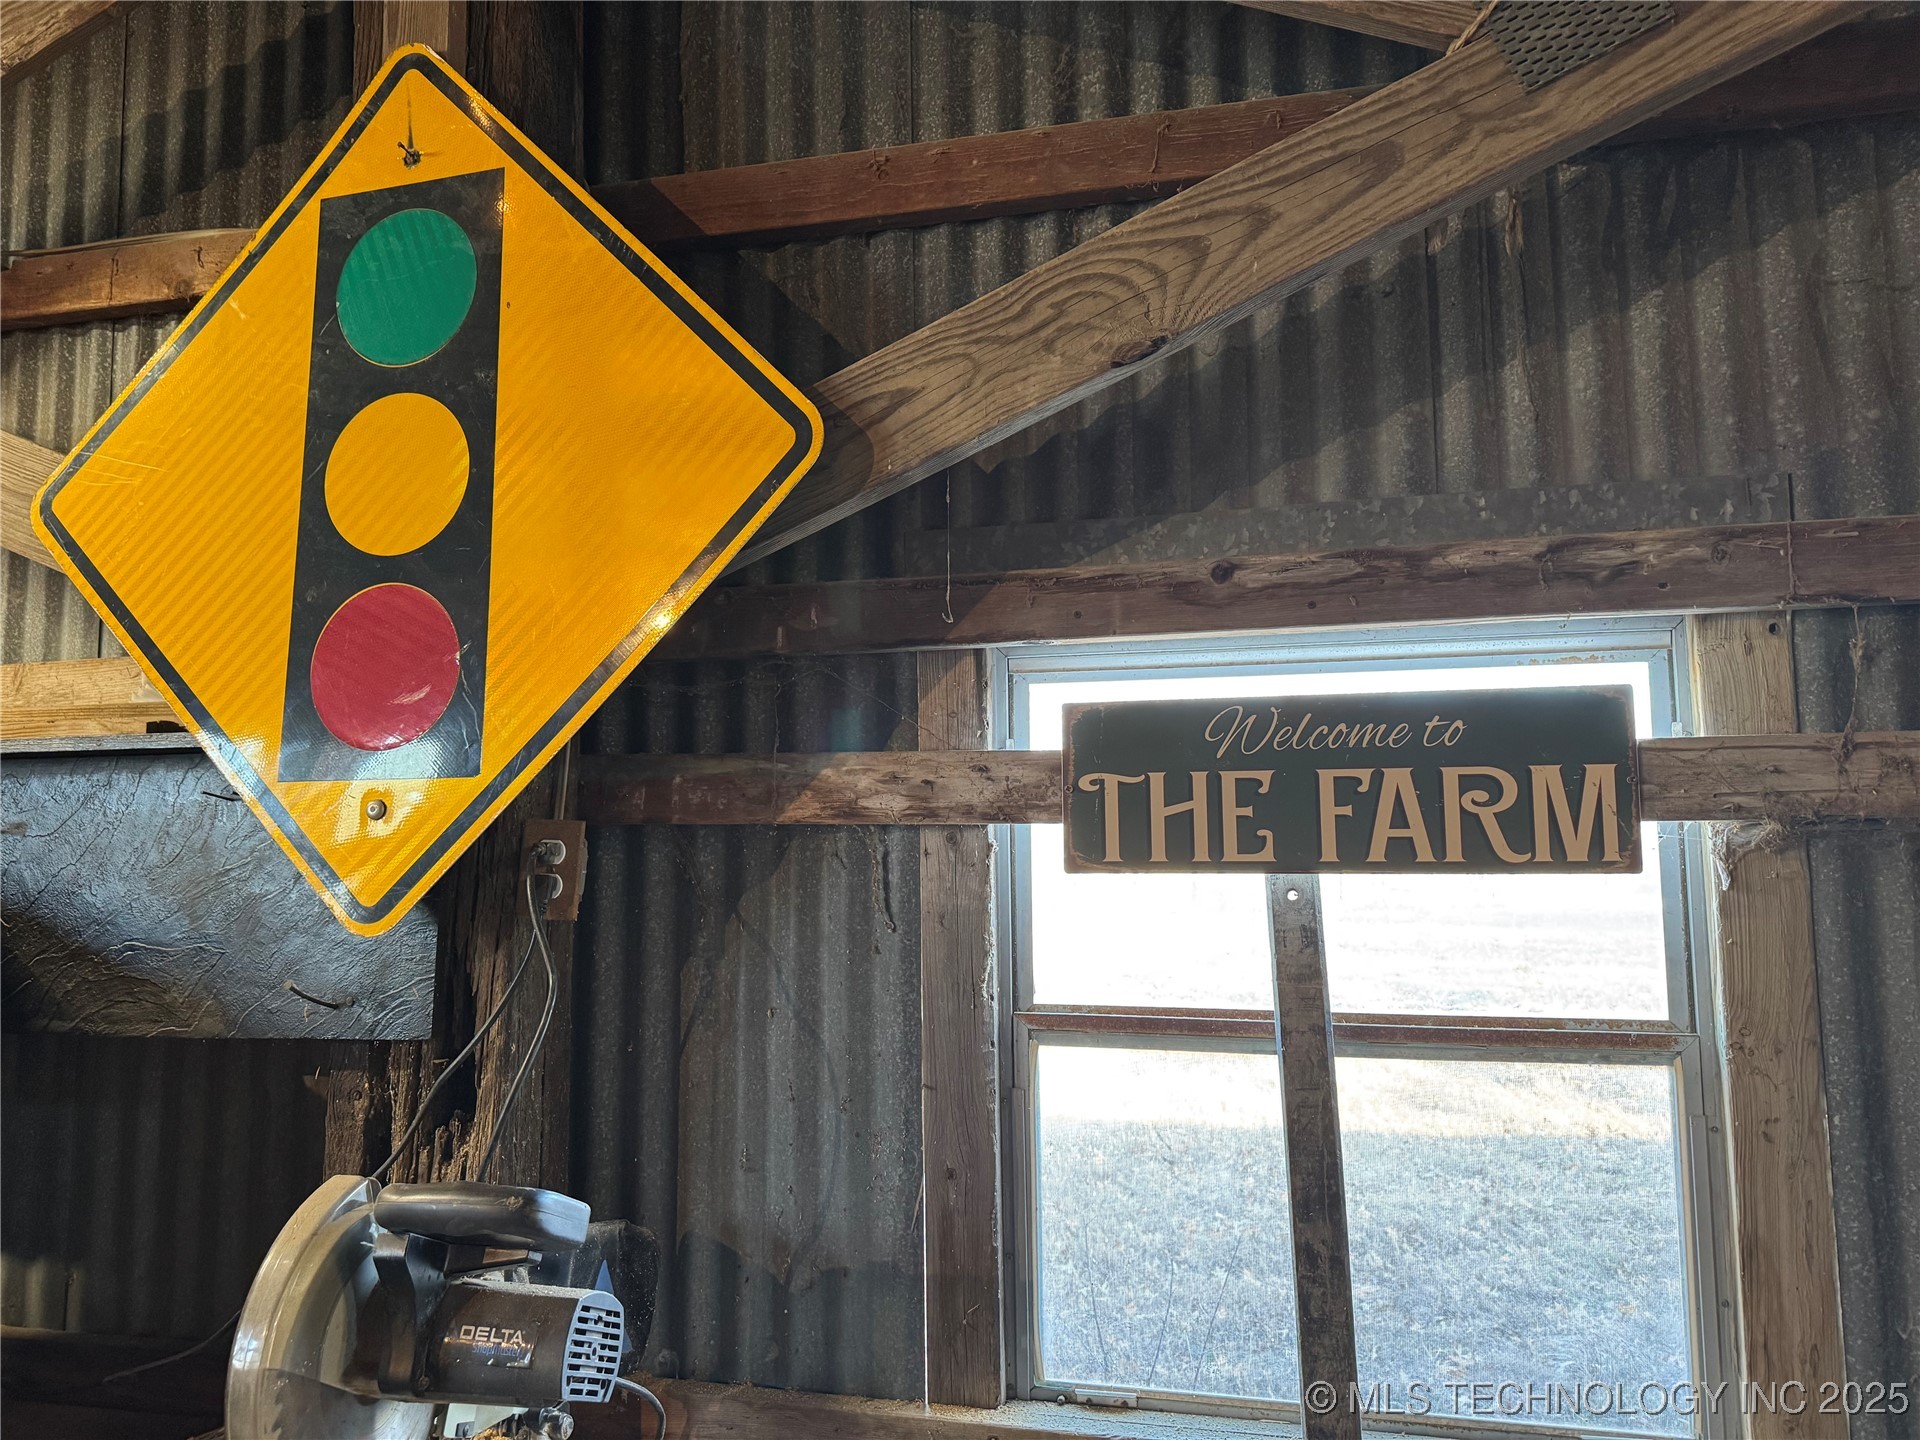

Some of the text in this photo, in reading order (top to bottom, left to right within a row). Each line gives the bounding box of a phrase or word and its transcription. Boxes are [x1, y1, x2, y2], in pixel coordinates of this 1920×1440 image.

[1205, 706, 1468, 758] Welcome to
[1078, 764, 1622, 863] THE FARM
[460, 1325, 524, 1344] DELTA
